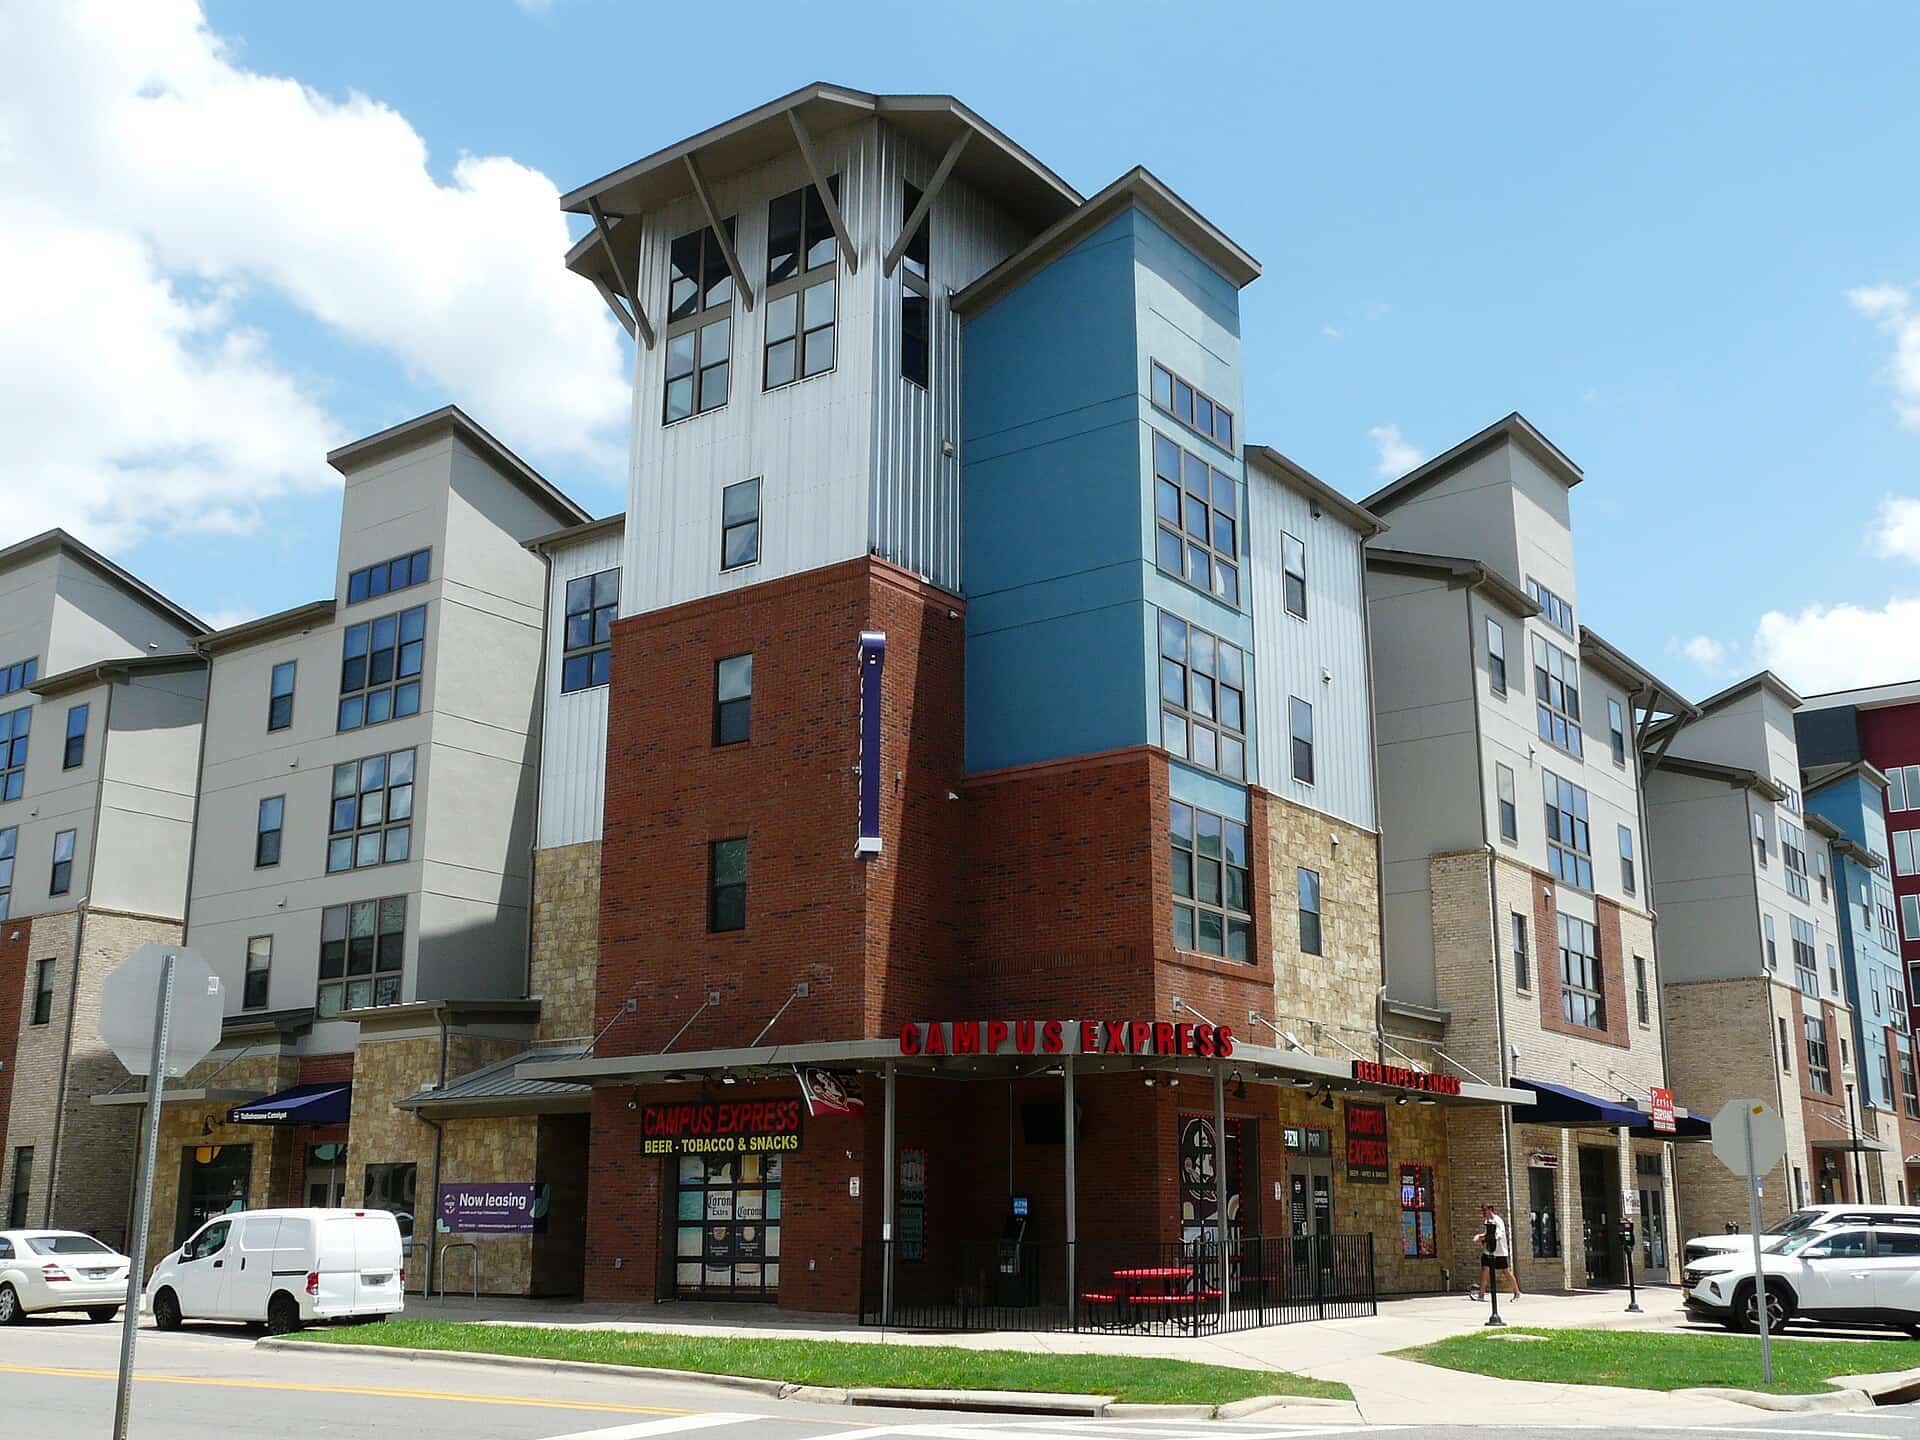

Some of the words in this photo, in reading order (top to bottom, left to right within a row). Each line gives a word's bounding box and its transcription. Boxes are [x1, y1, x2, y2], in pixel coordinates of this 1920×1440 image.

[900, 1020, 1063, 1055] CAMPUS
[1080, 1021, 1234, 1057] EXPRESS
[1355, 1060, 1383, 1083] BEER
[1385, 1065, 1417, 1088] VAPES
[1427, 1073, 1461, 1095] SNACKS
[644, 1104, 713, 1136] CAMPUS
[715, 1100, 800, 1133] EXPRESS
[644, 1140, 672, 1153] BEER
[681, 1138, 734, 1152] TOBACCO
[738, 1137, 746, 1150] &
[750, 1135, 798, 1150] SNACKS
[459, 1193, 483, 1207] Now
[485, 1192, 526, 1210] leasing
